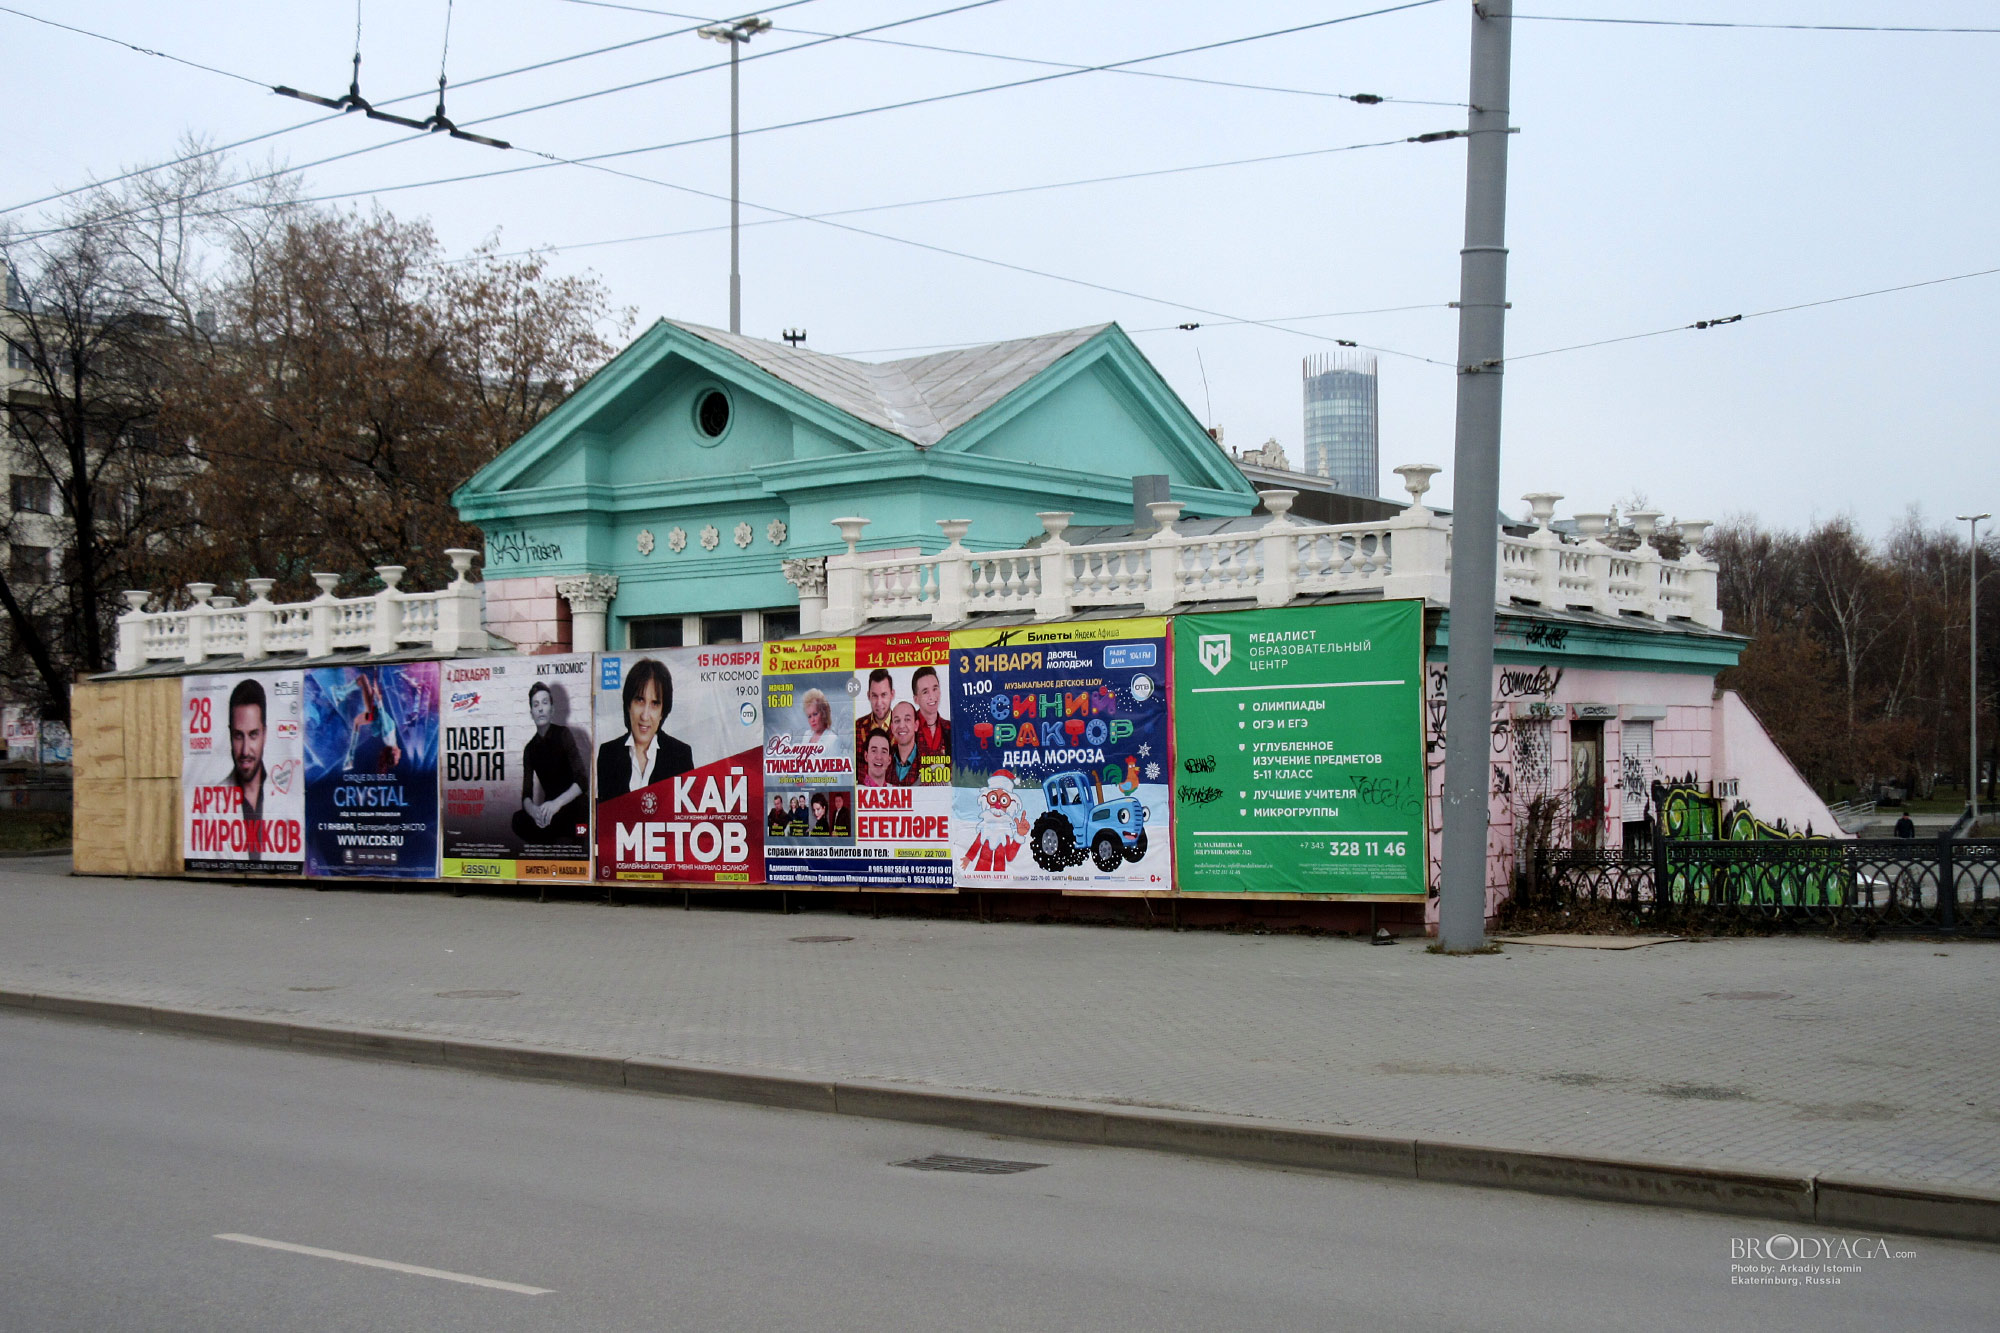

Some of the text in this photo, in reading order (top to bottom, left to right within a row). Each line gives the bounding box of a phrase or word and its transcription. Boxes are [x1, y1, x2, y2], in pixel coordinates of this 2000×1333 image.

[886, 638, 897, 646] КЗ
[914, 635, 950, 645] Лаврова
[1028, 628, 1120, 642] Билеты Яндекс Афиша
[1249, 630, 1316, 643] МЕДАЛИСТ
[769, 644, 781, 654] КЗ
[799, 643, 837, 655] Лаврова
[1250, 640, 1371, 656] ОБРАЗОВАТЕЛЬНЫЙ
[697, 652, 760, 667] 15 НОЯБРЯ
[868, 646, 950, 666] 14 декабря
[1047, 650, 1077, 661] ДВОРЕЦ
[536, 662, 587, 675] ККТ "КОСМОС"
[769, 654, 840, 672] 8 декабря
[959, 652, 1043, 674] 3 ЯНВАРЯ
[1047, 659, 1093, 670] МОЛОДЕЖИ
[1250, 660, 1288, 671] ЦЕНТР
[452, 667, 490, 683] ДЕКАБРЯ
[700, 670, 759, 682] ККТ КОСМОС
[769, 684, 793, 692] начало
[847, 682, 860, 692] 6+
[962, 679, 992, 696] 11:00
[1004, 678, 1103, 691] МУЗЫКАЛЬНОЕ ДЕТСКОЕ ШОУ
[767, 694, 793, 707] 16:00
[990, 686, 1117, 721] СИНИЙ
[1252, 700, 1325, 712] ОЛИМПИАДЫ
[190, 697, 211, 734] 28
[1252, 718, 1308, 729] ОГЭ И ЕГЭ
[446, 726, 504, 750] ПАВЕЛ
[973, 718, 1134, 749] ТРАКТОР
[1253, 741, 1333, 752] УГЛУБЛЕННОЕ
[921, 755, 950, 765] начало
[1002, 749, 1105, 768] ДЕДА МОРОЗА
[1253, 754, 1382, 766] ИЗУЧЕНИЕ ПРЕДМЕТОВ
[447, 752, 505, 781] ВОЛЯ
[343, 774, 366, 783] CIRQUE
[919, 767, 950, 783] 16:00
[1253, 769, 1313, 779] 5-11 КЛАСС
[333, 785, 409, 806] CRYSTAL
[448, 787, 484, 801] БОЛЬШОЙ
[674, 767, 748, 813] КАЙ
[1253, 789, 1357, 800] ЛУЧШИЕ УЧИТЕЛЯ
[192, 786, 244, 813] АРТУР
[857, 789, 912, 809] КАЗАН
[1254, 807, 1339, 818] МИКРОГРУППЫ
[858, 816, 949, 838] ЕГЕТЛӘРЕ
[191, 819, 301, 853] ПИРОЖКОВ
[337, 835, 404, 846] WWW.CDS.RU
[616, 822, 749, 863] МЕТОВ
[767, 848, 799, 858] справки
[805, 849, 828, 857] заказ
[829, 848, 862, 857] билетов
[863, 849, 872, 857] по
[874, 849, 890, 857] тел:
[1329, 842, 1406, 856] 328 11 46
[461, 862, 501, 876] kassy.ru
[525, 866, 549, 875] БИЛЕТЫ
[650, 863, 675, 871] КОНЦЕРТ
[944, 876, 952, 884] 29
